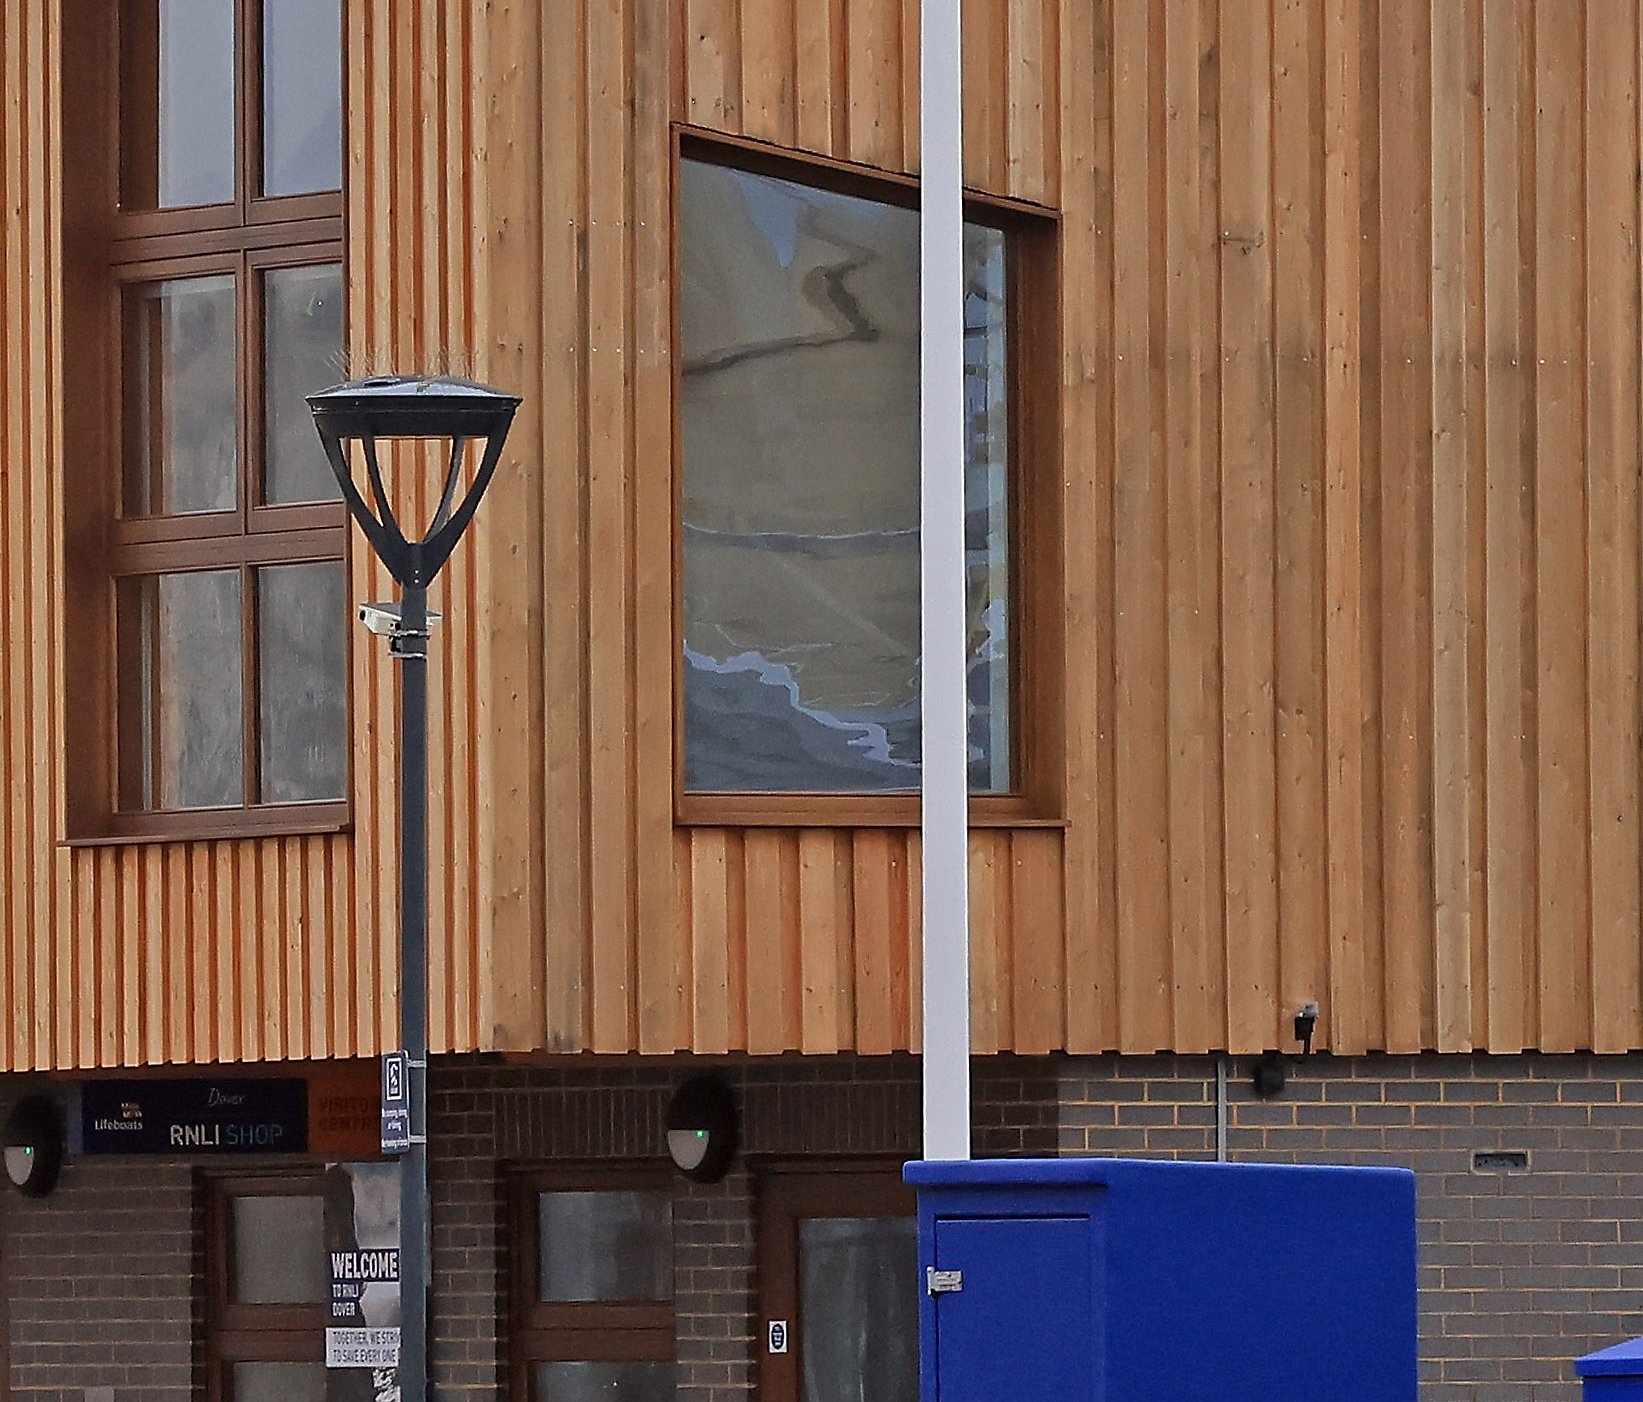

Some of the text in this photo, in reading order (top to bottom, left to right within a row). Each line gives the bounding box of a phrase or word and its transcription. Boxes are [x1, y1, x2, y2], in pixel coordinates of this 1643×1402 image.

[95, 1118, 143, 1130] Lifeboats
[170, 1123, 283, 1146] RNLI SHOP
[331, 1252, 398, 1279] WELCOME
[332, 1302, 355, 1316] DOVER
